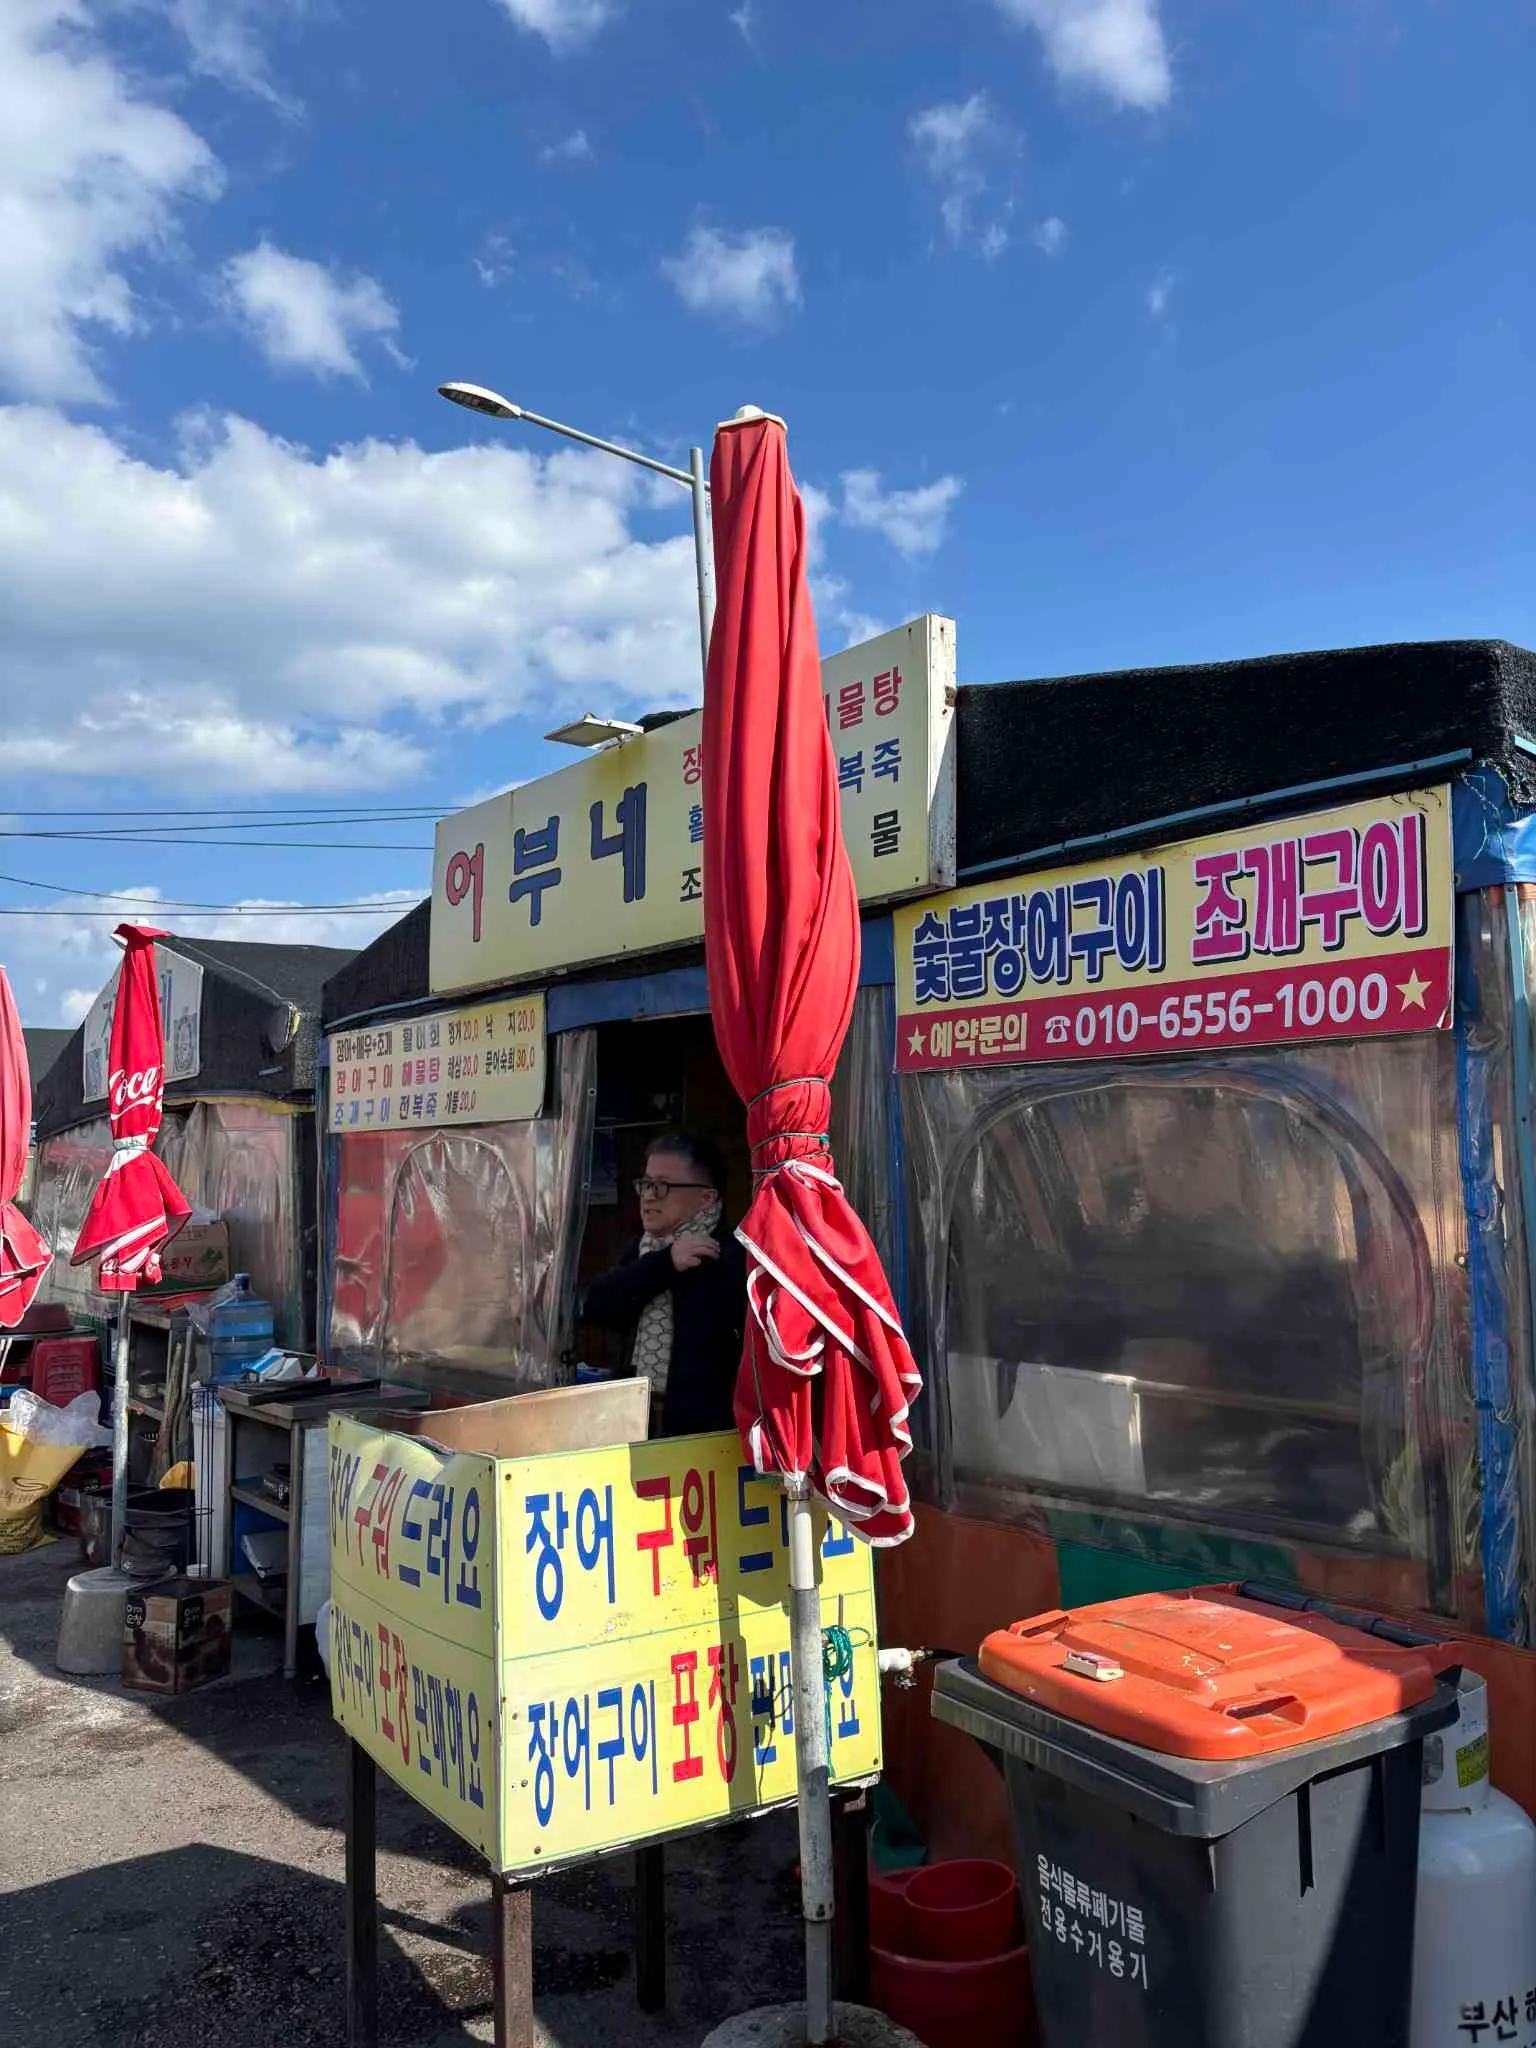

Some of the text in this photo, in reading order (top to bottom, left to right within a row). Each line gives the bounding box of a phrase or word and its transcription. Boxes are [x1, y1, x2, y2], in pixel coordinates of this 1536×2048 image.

[823, 664, 904, 732] 물탕
[445, 782, 648, 942] 어부네
[912, 812, 1427, 1004] 숯불장어구이 조개구이
[928, 972, 1388, 1058] 예약문의 010-6556-1000
[335, 1096, 391, 1125] 조개구이
[336, 1064, 393, 1094] 장어구이
[330, 1445, 482, 1609] 장어 구워 드려요
[525, 1484, 615, 1621] 장어
[637, 1468, 719, 1592] 구워
[335, 1606, 484, 1810] 장어구이 포장 판매해요
[528, 1679, 658, 1827] 장어구이
[671, 1642, 739, 1784] 포장
[1037, 1853, 1146, 1945] 음식물류폐기물
[1040, 1894, 1148, 1990] 전용수거용기
